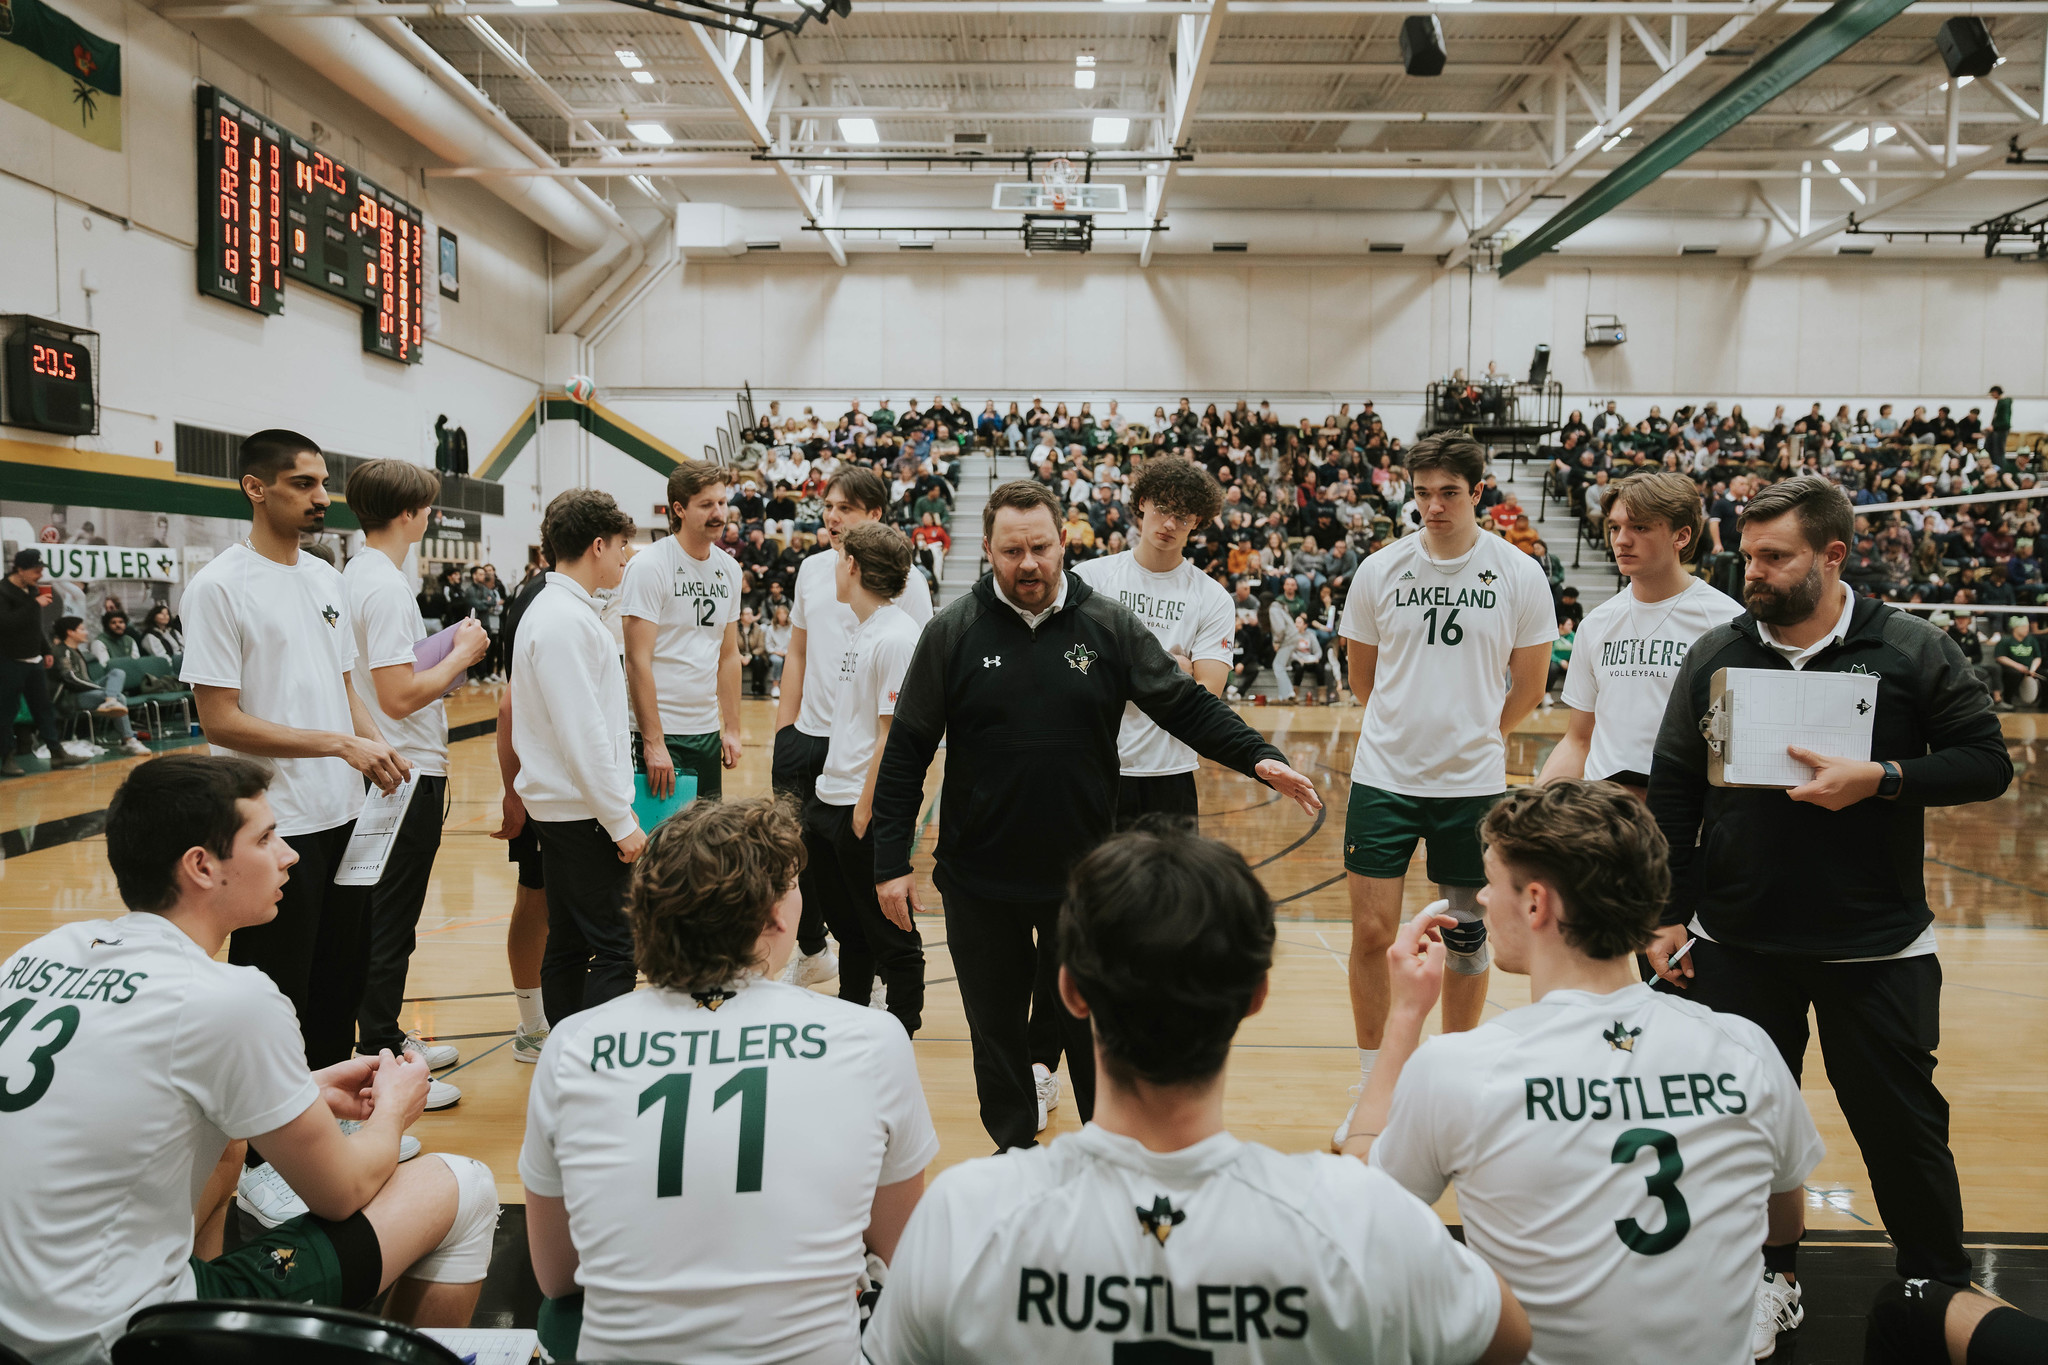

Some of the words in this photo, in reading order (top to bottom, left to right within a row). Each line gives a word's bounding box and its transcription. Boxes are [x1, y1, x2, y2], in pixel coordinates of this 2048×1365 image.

[220, 115, 239, 146] 03
[254, 136, 260, 158] 1
[270, 145, 280, 169] 0
[225, 146, 239, 172] 10
[249, 158, 261, 184] 0
[270, 169, 280, 194] 0
[314, 151, 346, 194] 20.5
[220, 168, 239, 198] 02
[249, 183, 261, 209] 0
[270, 194, 280, 218] 0
[249, 208, 261, 234] 0
[270, 218, 280, 242] 0
[294, 228, 305, 254] 0
[225, 223, 239, 248] 11
[249, 233, 261, 259] 0
[270, 242, 280, 267] 0
[249, 258, 261, 284] 3
[274, 269, 280, 290] 1
[366, 262, 377, 286] 0
[249, 283, 261, 307] 0
[33, 344, 76, 380] 20.5
[47, 549, 152, 578] USTLER
[674, 582, 729, 598] LAKELAND
[1120, 590, 1186, 620] RUSTLERS
[1396, 586, 1496, 609] LAKELAND
[693, 598, 716, 627] 12
[1423, 607, 1464, 646] 16
[1602, 639, 1687, 667] RUSTLERS
[1609, 670, 1668, 678] VOLLEYBALL
[1, 957, 148, 1004] RUSTLERS
[0, 997, 80, 1112] 13
[591, 1023, 827, 1072] RUSTLERS
[1525, 1073, 1747, 1121] RUSTLERS
[637, 1066, 768, 1198] 11
[1611, 1128, 1691, 1256] 3
[1018, 1267, 1309, 1343] RUSTLERS
